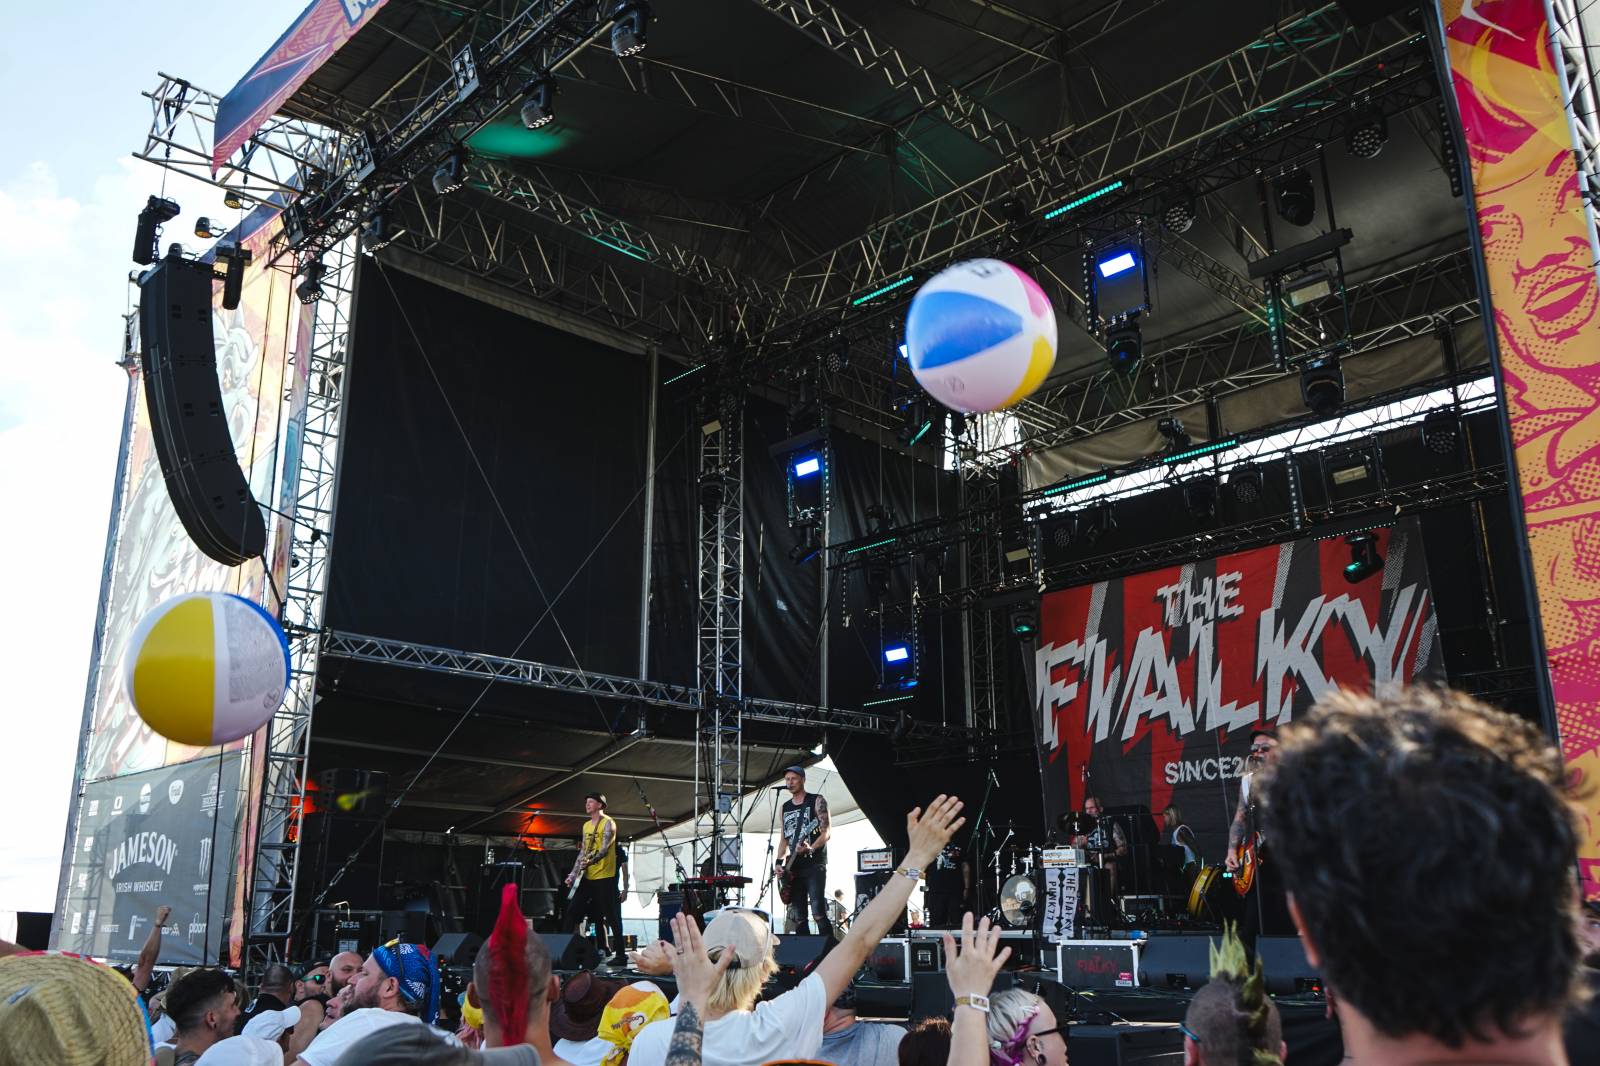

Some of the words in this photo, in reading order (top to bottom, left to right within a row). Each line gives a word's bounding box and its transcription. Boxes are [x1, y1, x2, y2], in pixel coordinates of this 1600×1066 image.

[1157, 570, 1245, 628] THE
[1036, 583, 1426, 751] FIALKY
[109, 832, 176, 880] JAMESON
[115, 881, 133, 894] IRISH
[133, 879, 164, 894] WHISKEY
[1066, 872, 1076, 894] THE
